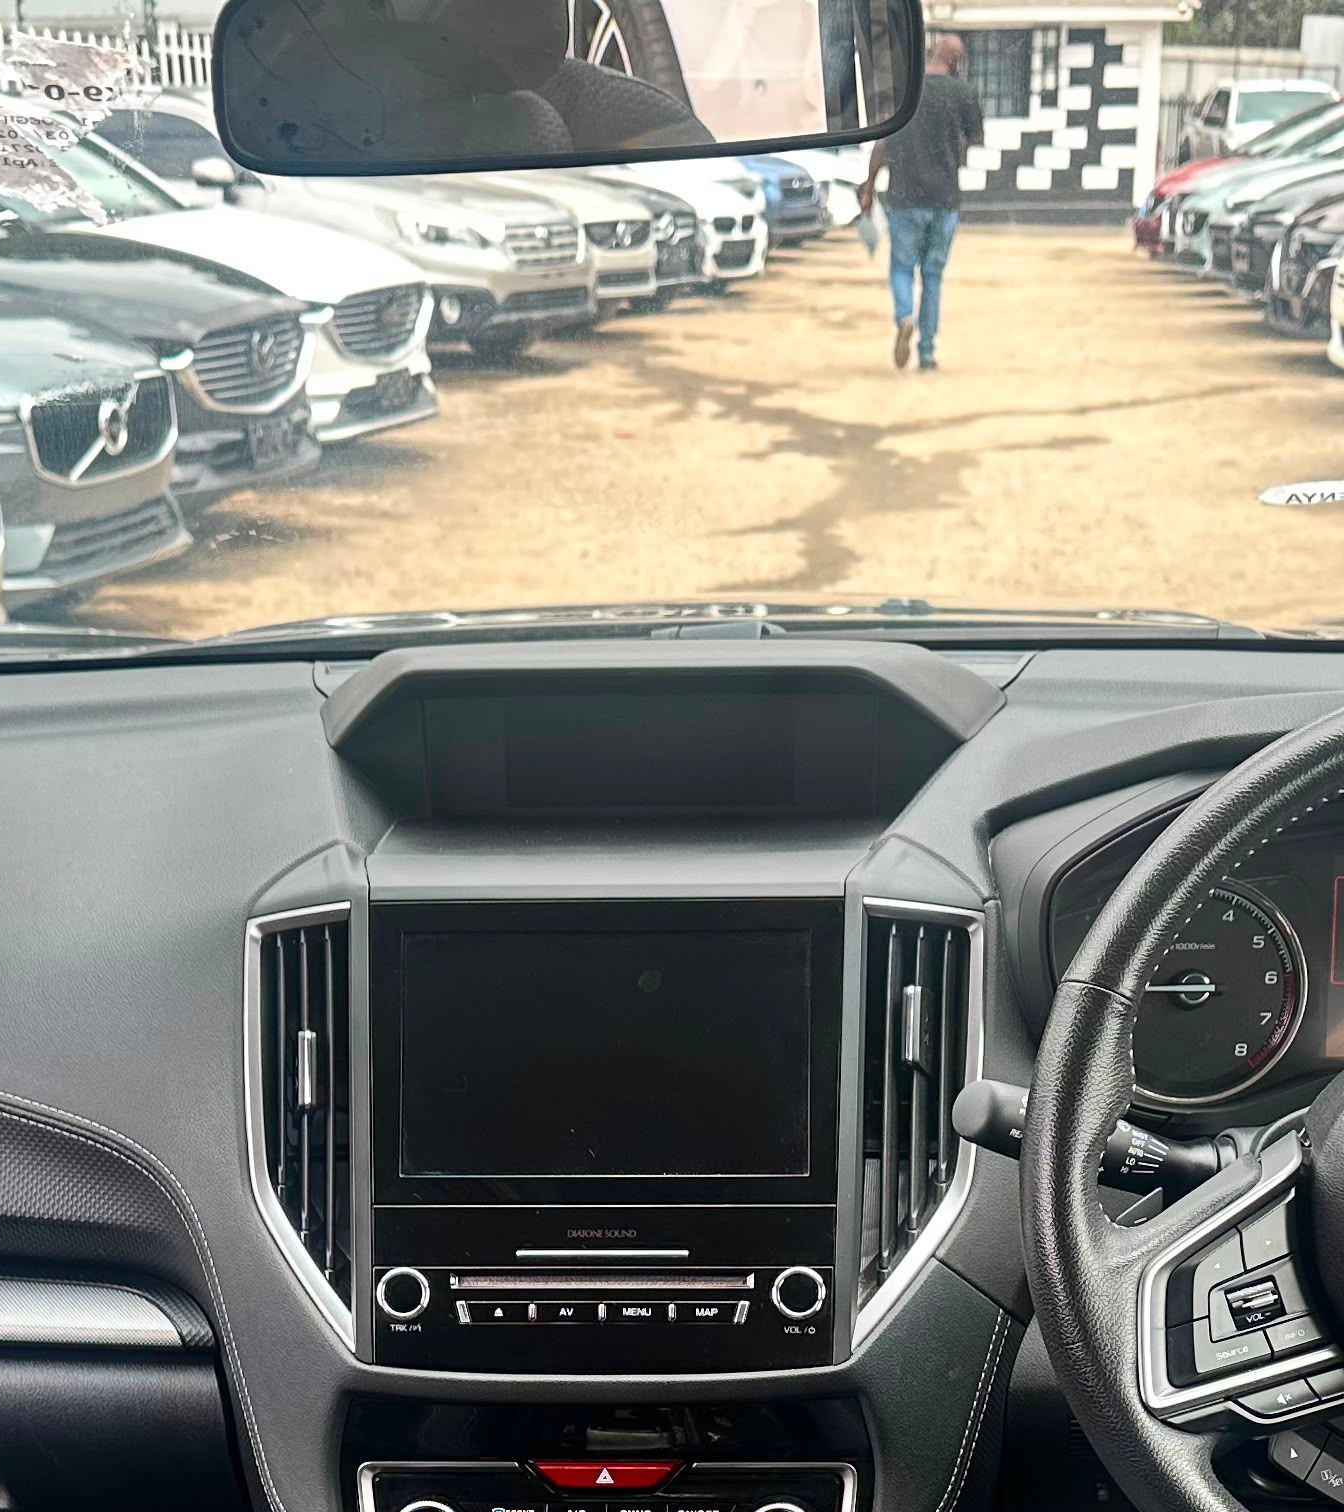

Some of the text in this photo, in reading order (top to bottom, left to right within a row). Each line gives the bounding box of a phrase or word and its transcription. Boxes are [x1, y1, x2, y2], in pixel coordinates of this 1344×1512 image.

[1222, 909, 1235, 922] 4
[1252, 935, 1265, 949] 5
[1264, 970, 1278, 985] 6
[1259, 1012, 1272, 1025] 7
[1234, 1043, 1248, 1057] 8
[566, 1228, 637, 1239] DIATONE SOUND
[559, 1307, 574, 1317] AV
[622, 1307, 652, 1317] MENU
[695, 1307, 719, 1317] MAP
[1215, 1344, 1250, 1361] Source
